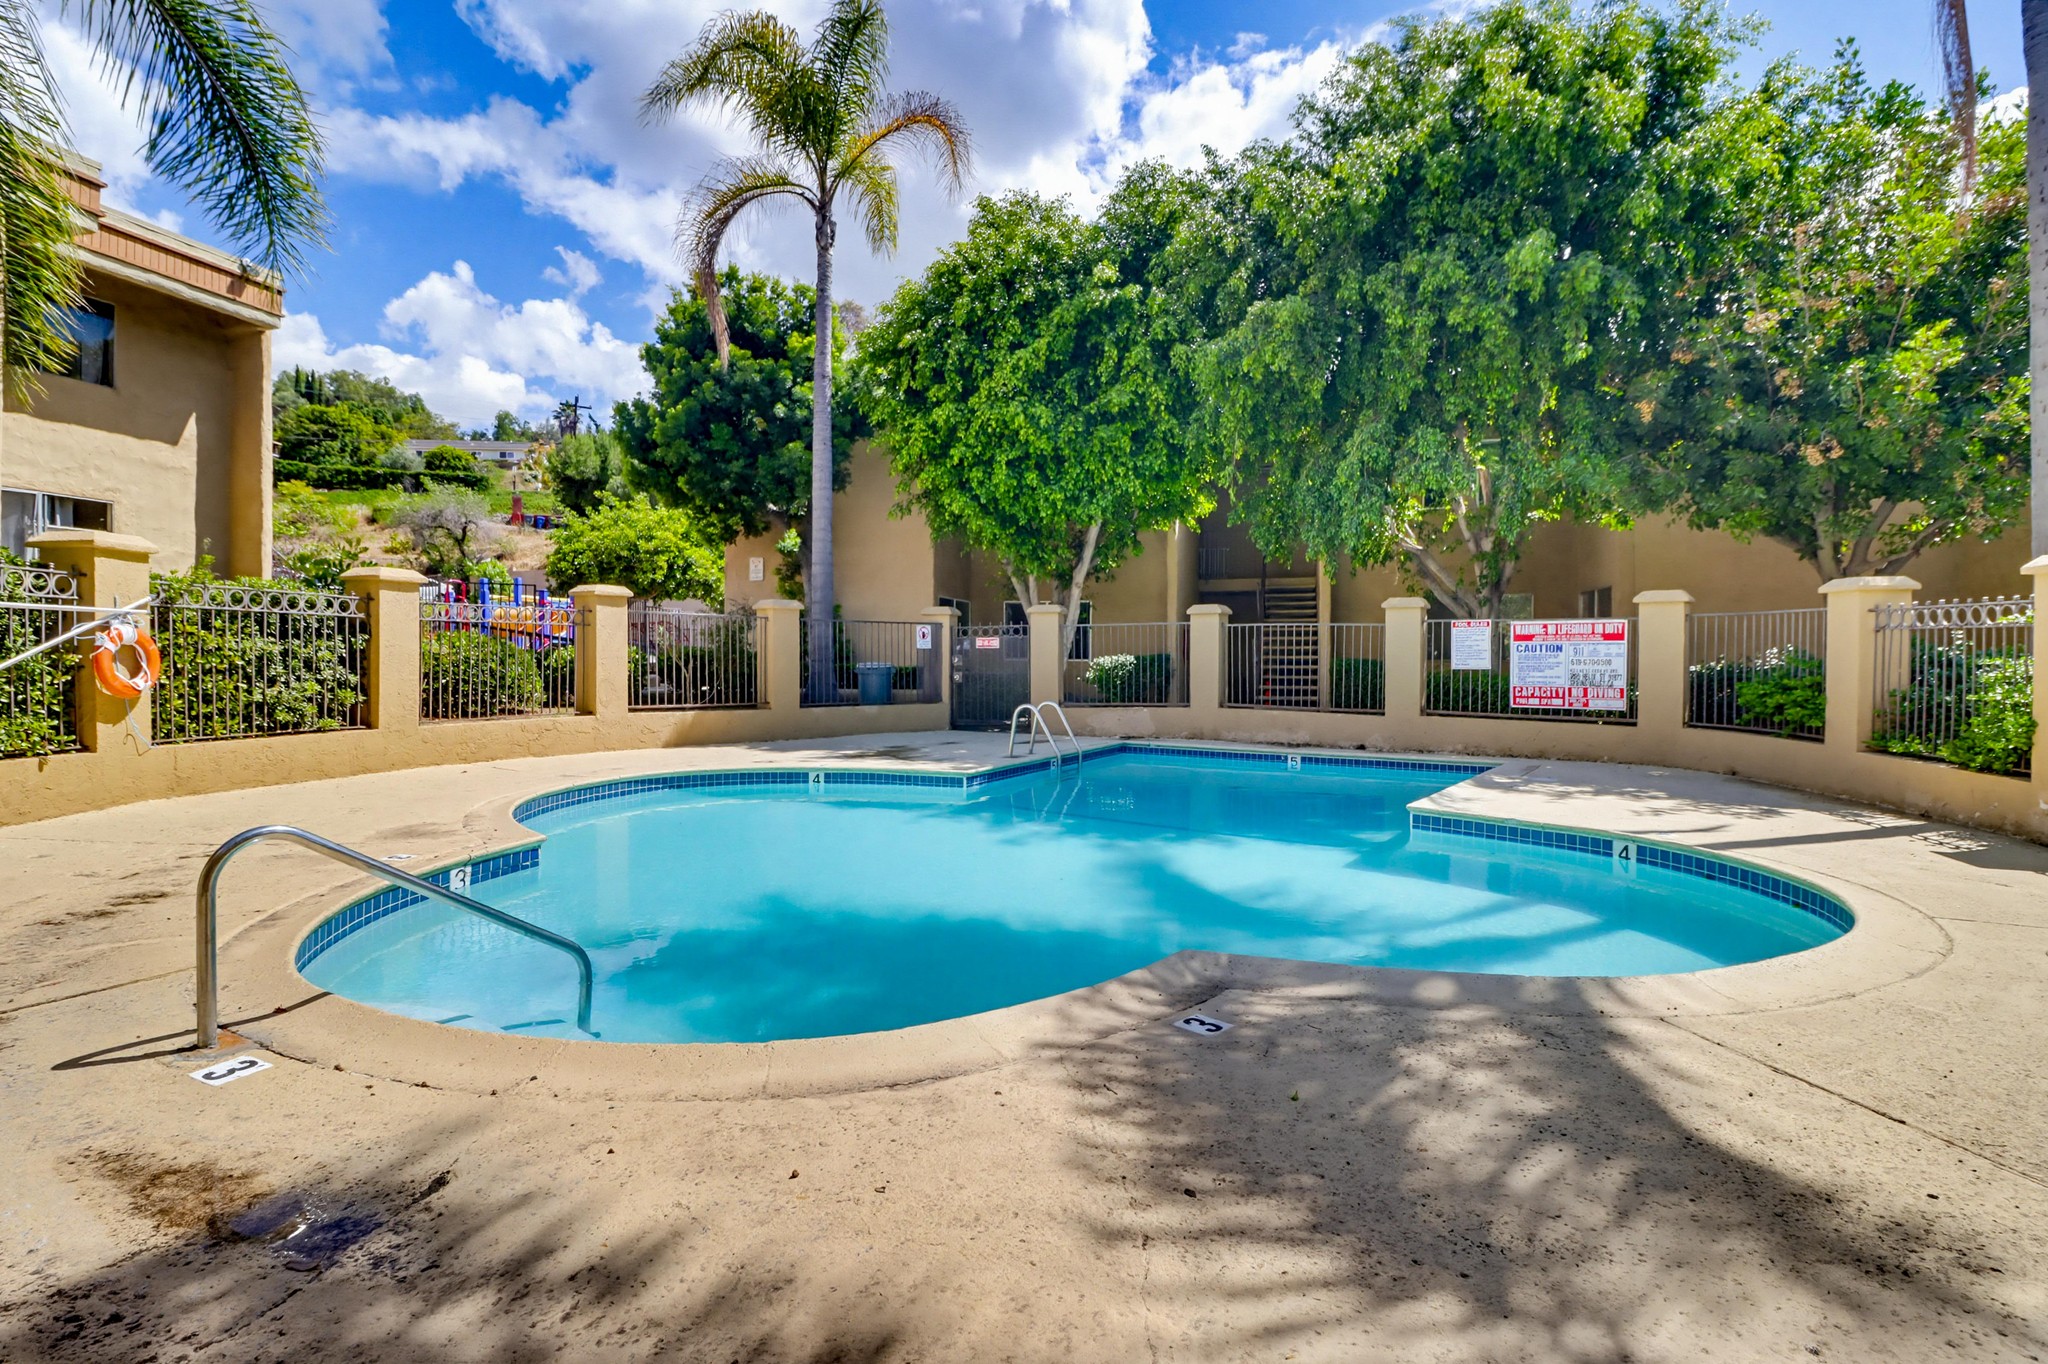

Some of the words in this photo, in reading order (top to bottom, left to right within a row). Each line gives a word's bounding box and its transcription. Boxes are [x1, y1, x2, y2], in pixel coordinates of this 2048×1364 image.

[1547, 624, 1557, 635] NO
[1557, 623, 1593, 635] LIFEGUARD
[1594, 623, 1603, 634] ON
[1605, 623, 1623, 634] DUTY
[1516, 643, 1563, 653] CAUTION
[1573, 647, 1584, 656] 911
[1515, 686, 1563, 698] CAPACITY
[1571, 687, 1583, 698] NO
[1587, 688, 1620, 699] DIVING
[1291, 756, 1298, 767] 5
[812, 773, 821, 783] 4
[1618, 844, 1631, 860] 4
[455, 868, 466, 890] 3
[1183, 1017, 1223, 1032] 3
[202, 1059, 259, 1081] 3
